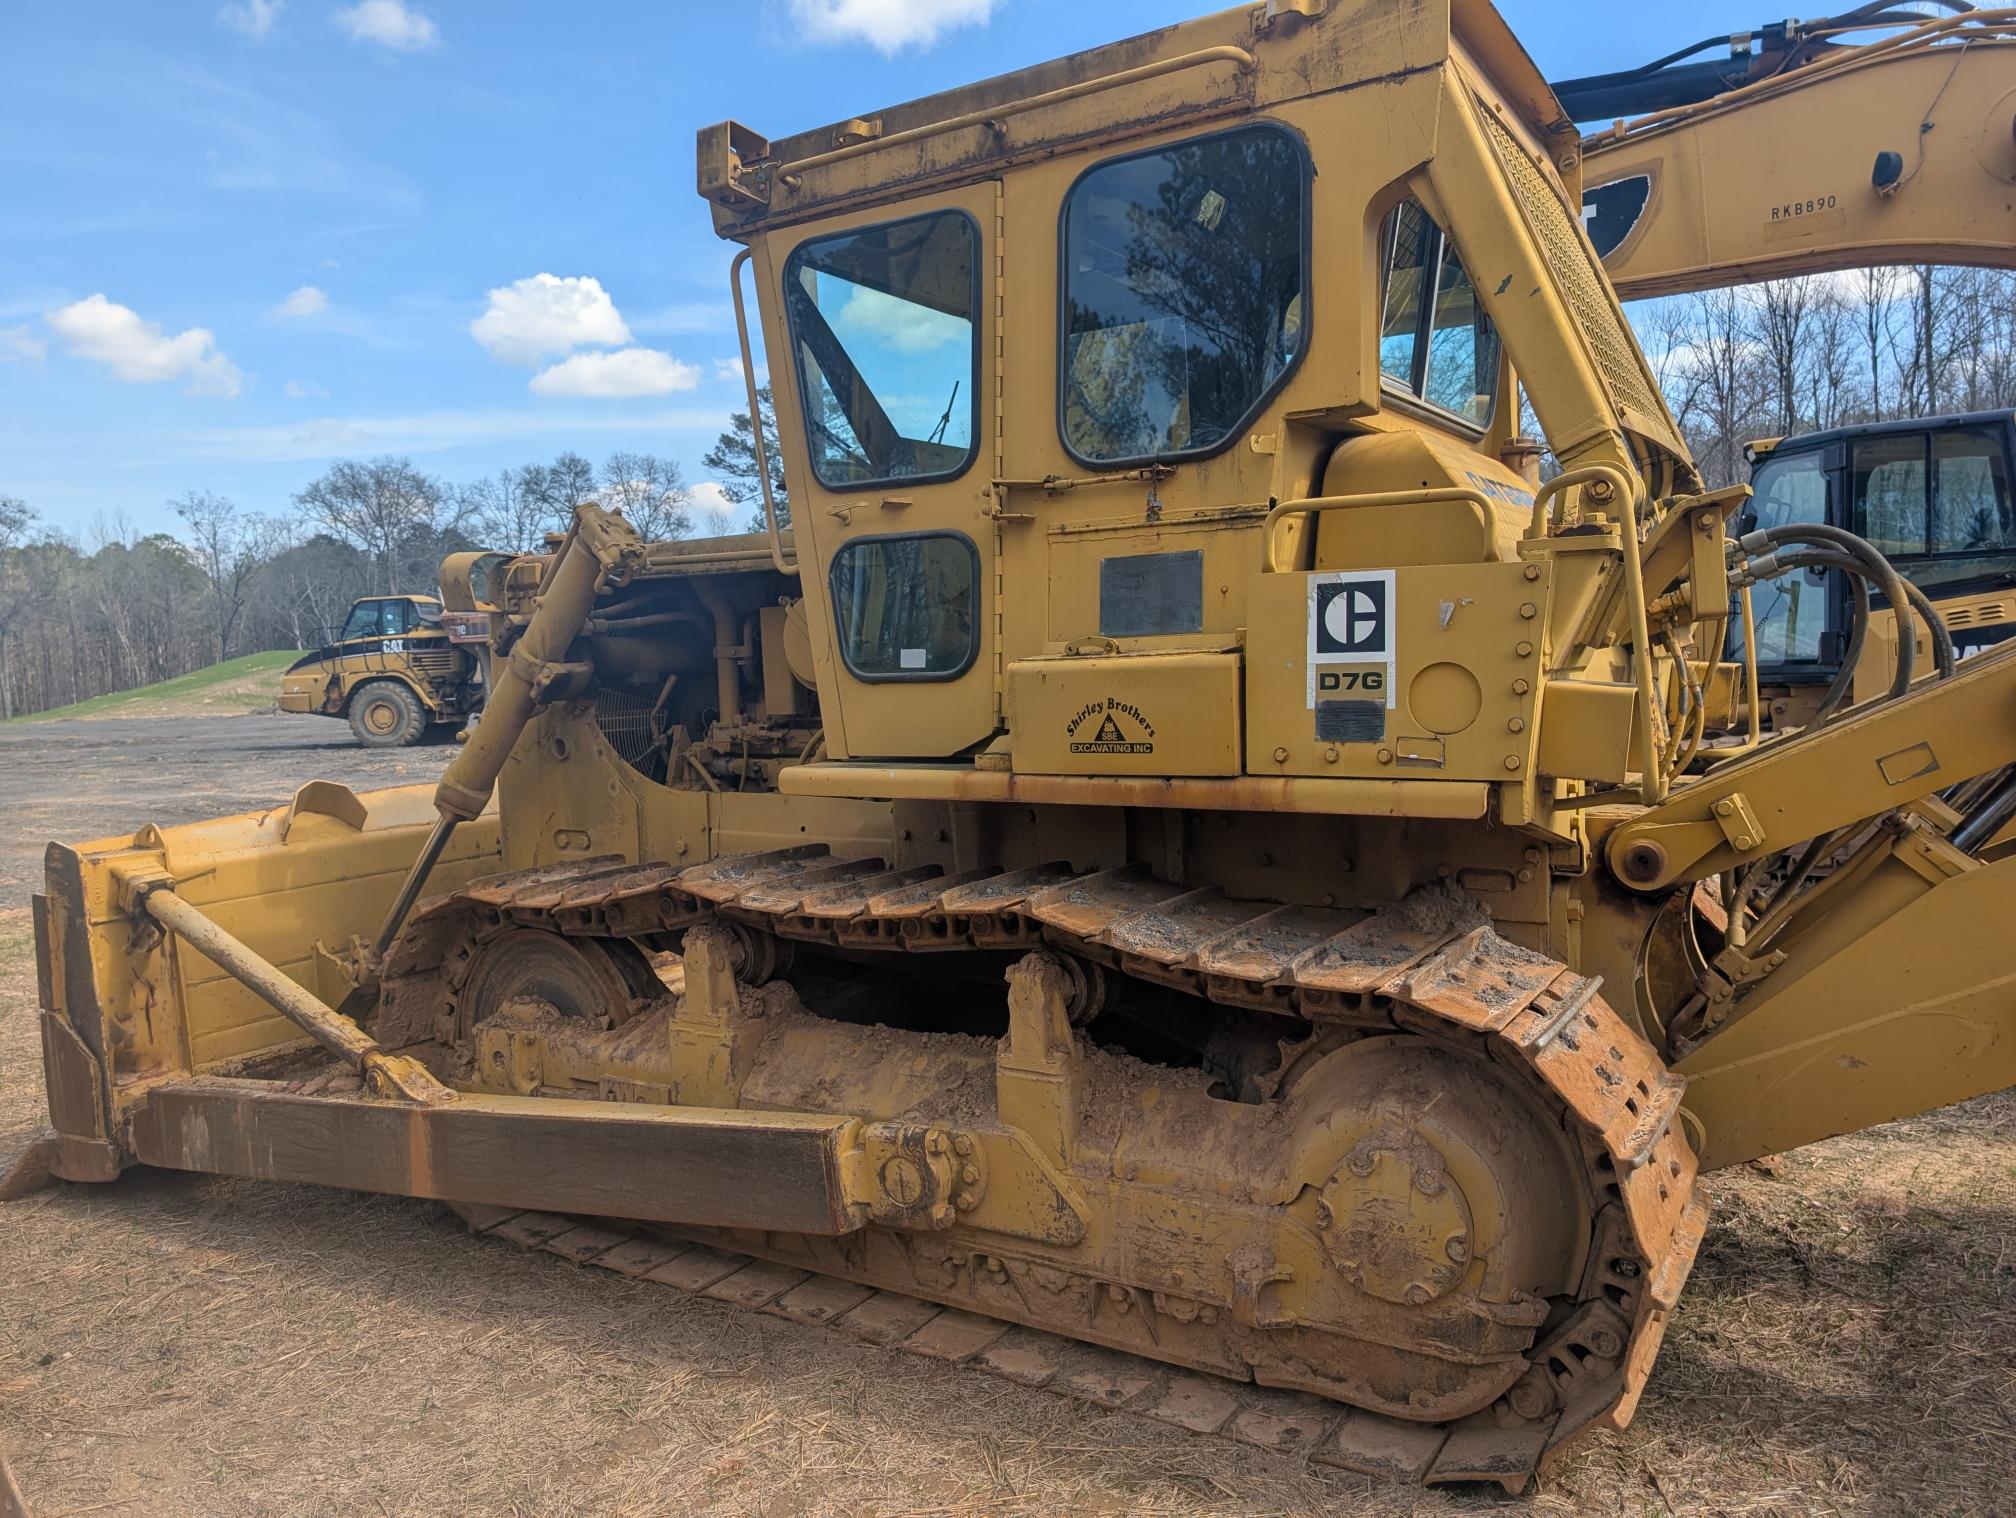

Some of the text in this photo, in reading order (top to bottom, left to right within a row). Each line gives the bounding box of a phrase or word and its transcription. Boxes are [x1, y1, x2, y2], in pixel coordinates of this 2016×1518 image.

[1771, 195, 1836, 220] RKB890
[382, 639, 404, 654] CAT
[1319, 672, 1383, 691] D7G
[1066, 697, 1156, 738] Shirley Brothers
[1101, 732, 1118, 741] SBE
[1071, 743, 1151, 753] EXCAVATING INC
